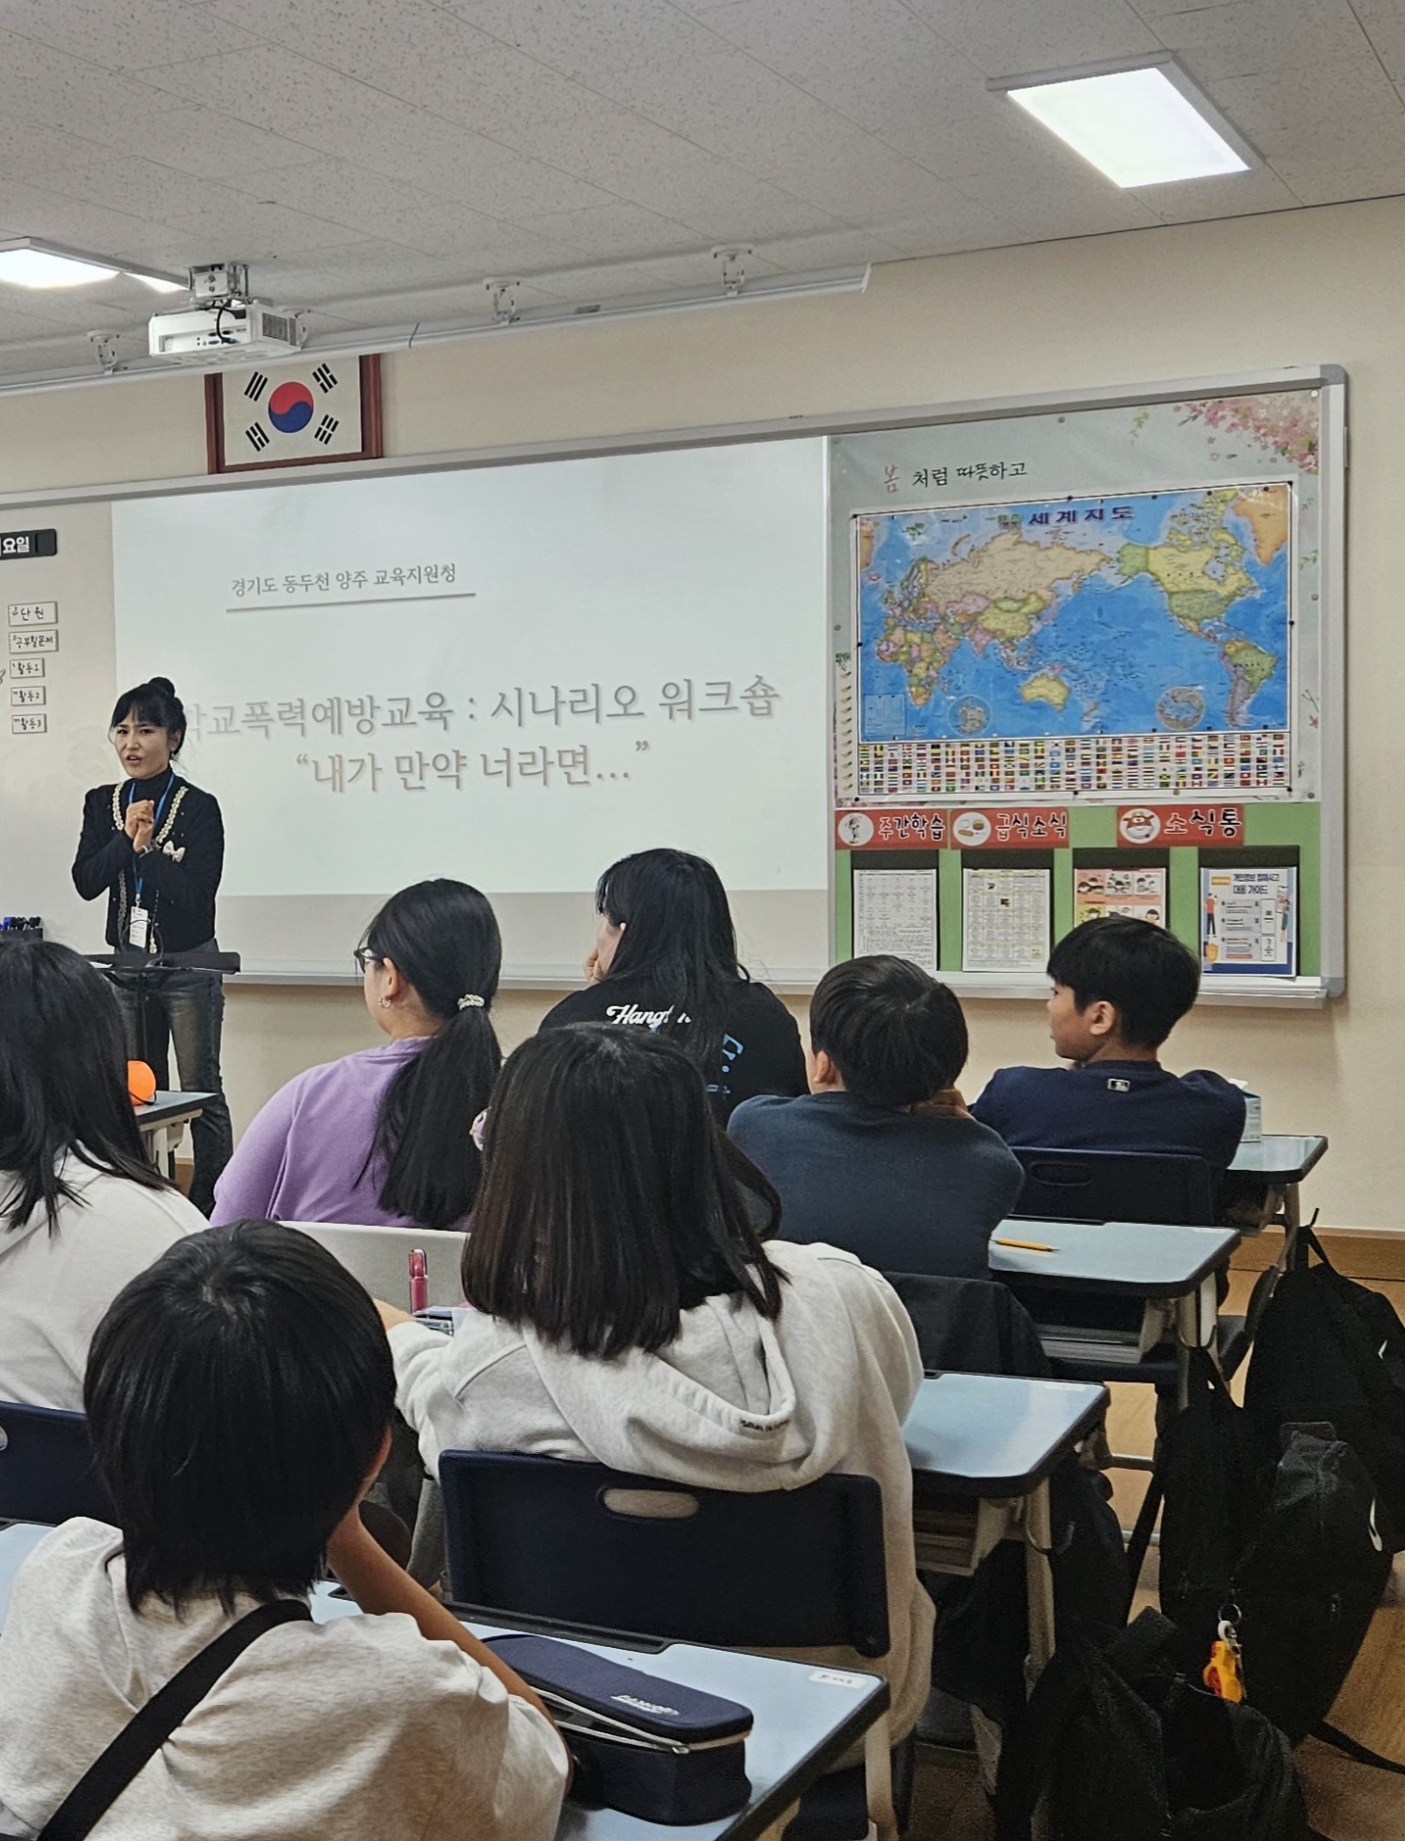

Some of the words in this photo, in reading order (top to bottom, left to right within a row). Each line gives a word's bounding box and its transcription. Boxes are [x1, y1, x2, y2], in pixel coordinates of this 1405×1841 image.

[882, 464, 899, 493] 봄
[912, 468, 948, 488] 처럼
[956, 461, 1028, 482] 따뜻하고
[1028, 505, 1135, 526] 세계지도
[231, 576, 278, 597] 경기도
[282, 572, 330, 594] 동두천
[335, 570, 368, 590] 양주
[373, 563, 456, 586] 교육지원청
[491, 683, 646, 728] 시나리오
[658, 674, 780, 722] 워크숍
[395, 749, 468, 792] 만약
[879, 812, 945, 841] 주간학습
[996, 811, 1068, 841] 급식소식
[1164, 808, 1243, 838] 소식통
